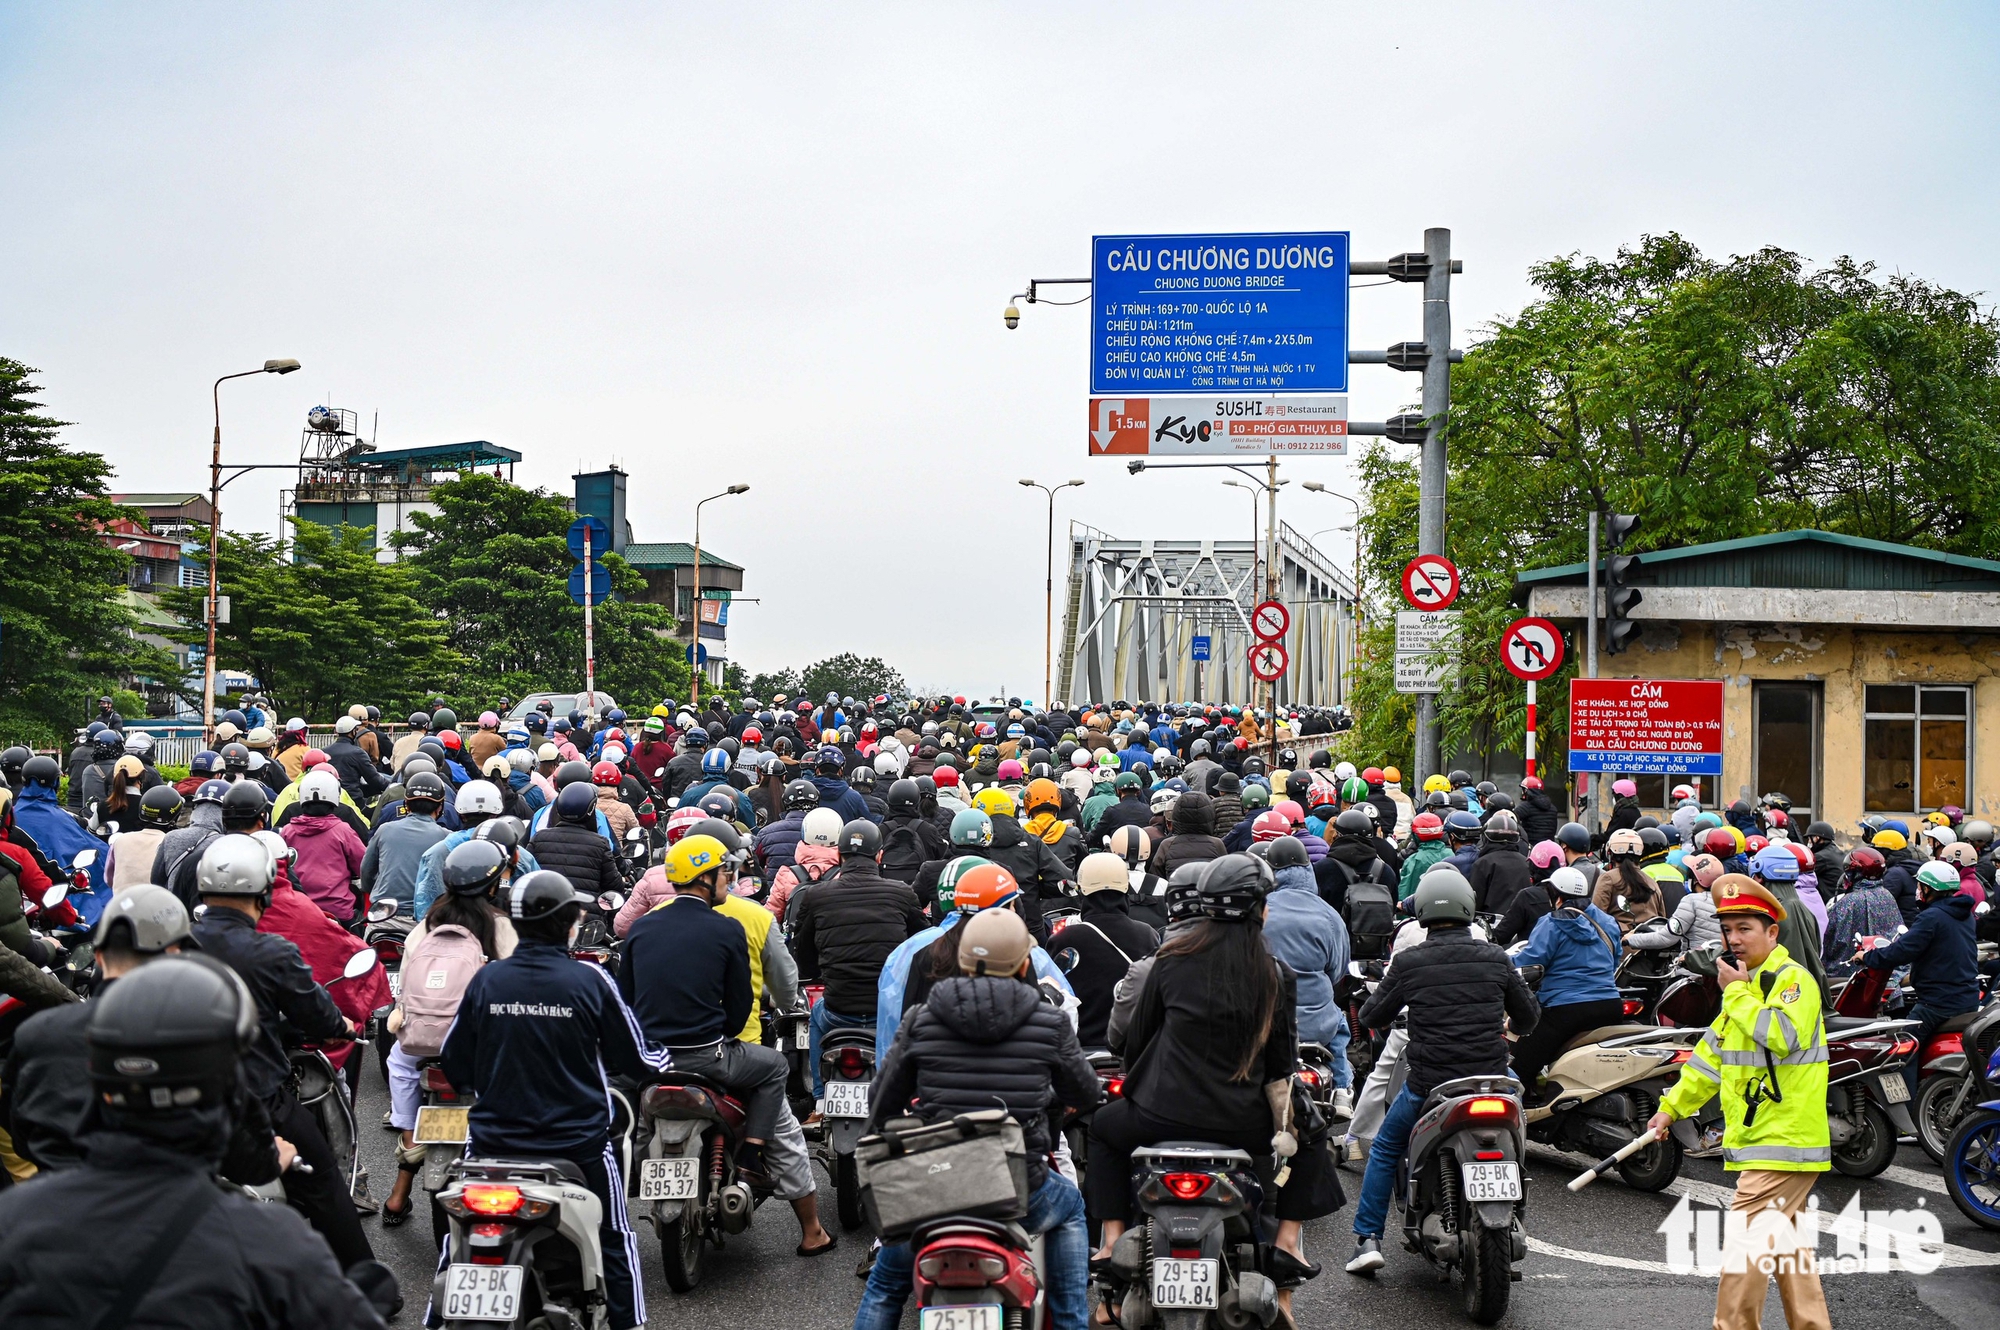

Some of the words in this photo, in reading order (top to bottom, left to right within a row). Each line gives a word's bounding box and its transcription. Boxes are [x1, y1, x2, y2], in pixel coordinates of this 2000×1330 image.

[1107, 243, 1151, 272] CẦU
[1157, 245, 1249, 271] CHƯƠNG
[1256, 244, 1334, 269] DƯƠNG
[1154, 277, 1199, 289] CHUONG
[1203, 276, 1241, 288] DUONG
[1245, 276, 1285, 287] BRIDGE
[1106, 302, 1117, 315] LÝ
[1205, 299, 1235, 314] QUỐC
[1239, 301, 1251, 316] LỘ
[1256, 303, 1268, 314] 1A
[1141, 333, 1171, 348] RỘNG
[1175, 331, 1212, 346] KHỐNG
[1141, 351, 1160, 362] CAO
[1165, 347, 1202, 362] KHỐNG
[1131, 368, 1140, 380] VỊ
[1143, 365, 1171, 379] QUẢN
[1192, 364, 1214, 374] CÔNG
[1217, 365, 1227, 373] TY
[1231, 365, 1250, 373] TNHH
[1254, 362, 1269, 373] NHÀ
[1272, 362, 1293, 373] NƯỚC
[1305, 364, 1315, 372] TV
[1192, 375, 1214, 386] CÔNG
[1217, 375, 1239, 385] TRÌNH
[1243, 377, 1253, 385] GT
[1256, 375, 1267, 385] HÀ
[1271, 375, 1284, 387] NỘI
[1216, 401, 1262, 416] SUSHI
[1264, 405, 1286, 416] 寿司
[1287, 406, 1336, 414] Restaurant
[1233, 424, 1245, 434] 10
[1254, 422, 1276, 434] PHỐ
[1278, 424, 1296, 434] GIA
[1298, 424, 1328, 435] THỤY,
[1330, 424, 1342, 434] LB
[1287, 442, 1307, 450] 0912
[1309, 442, 1326, 450] 212
[1327, 442, 1342, 450] 986
[1420, 612, 1438, 623] CẤM
[1631, 681, 1662, 698] CẤM
[1631, 701, 1646, 709] HỢP
[1648, 698, 1669, 708] ĐỒNG
[1601, 710, 1618, 718] LỊCH
[1626, 710, 1631, 718] 9
[1590, 717, 1601, 727] TẢI
[1602, 718, 1613, 727] CÓ
[1614, 720, 1639, 728] TRỌNG
[1640, 718, 1652, 728] TẢI
[1654, 719, 1674, 728] TOÀN
[1675, 720, 1686, 730] BỘ
[1705, 719, 1720, 730] TẤN
[1621, 729, 1636, 738] THÔ
[1650, 729, 1672, 738] NGƯỜI
[1674, 731, 1682, 739] ĐI
[1683, 730, 1694, 740] BỘ
[1586, 740, 1605, 749] QUA
[1607, 738, 1627, 749] CẦU
[1629, 740, 1668, 750] CHƯƠNG
[1671, 742, 1703, 751] DƯƠNG
[1599, 752, 1605, 761] Ô
[1607, 752, 1617, 761] TÔ
[1618, 753, 1634, 762] CHỞ
[1635, 755, 1650, 763] HỌC
[1685, 754, 1705, 764] BUÝT
[1602, 763, 1622, 772] ĐƯỢC
[1624, 762, 1644, 771] PHÉP
[1645, 765, 1664, 773] HOẠT
[1667, 764, 1687, 773] ĐỘNG
[688, 852, 711, 867] be
[490, 1004, 506, 1016] HỌC
[506, 1001, 526, 1017] VIỆN
[526, 1002, 549, 1016] NGÂN
[549, 1003, 573, 1018] HÀNG
[832, 1084, 867, 1100] 29-C1
[826, 1100, 869, 1115] 069.83
[425, 1109, 463, 1123] 36-F5
[650, 1162, 691, 1179] 36-B2
[1471, 1165, 1510, 1181] 29-BK
[644, 1179, 694, 1197] 695.37
[1469, 1182, 1517, 1198] 035.48
[457, 1268, 510, 1292] 29-BK
[1163, 1262, 1209, 1283] 29-E3
[1157, 1284, 1213, 1306] 004.84
[449, 1293, 514, 1317] 091.49
